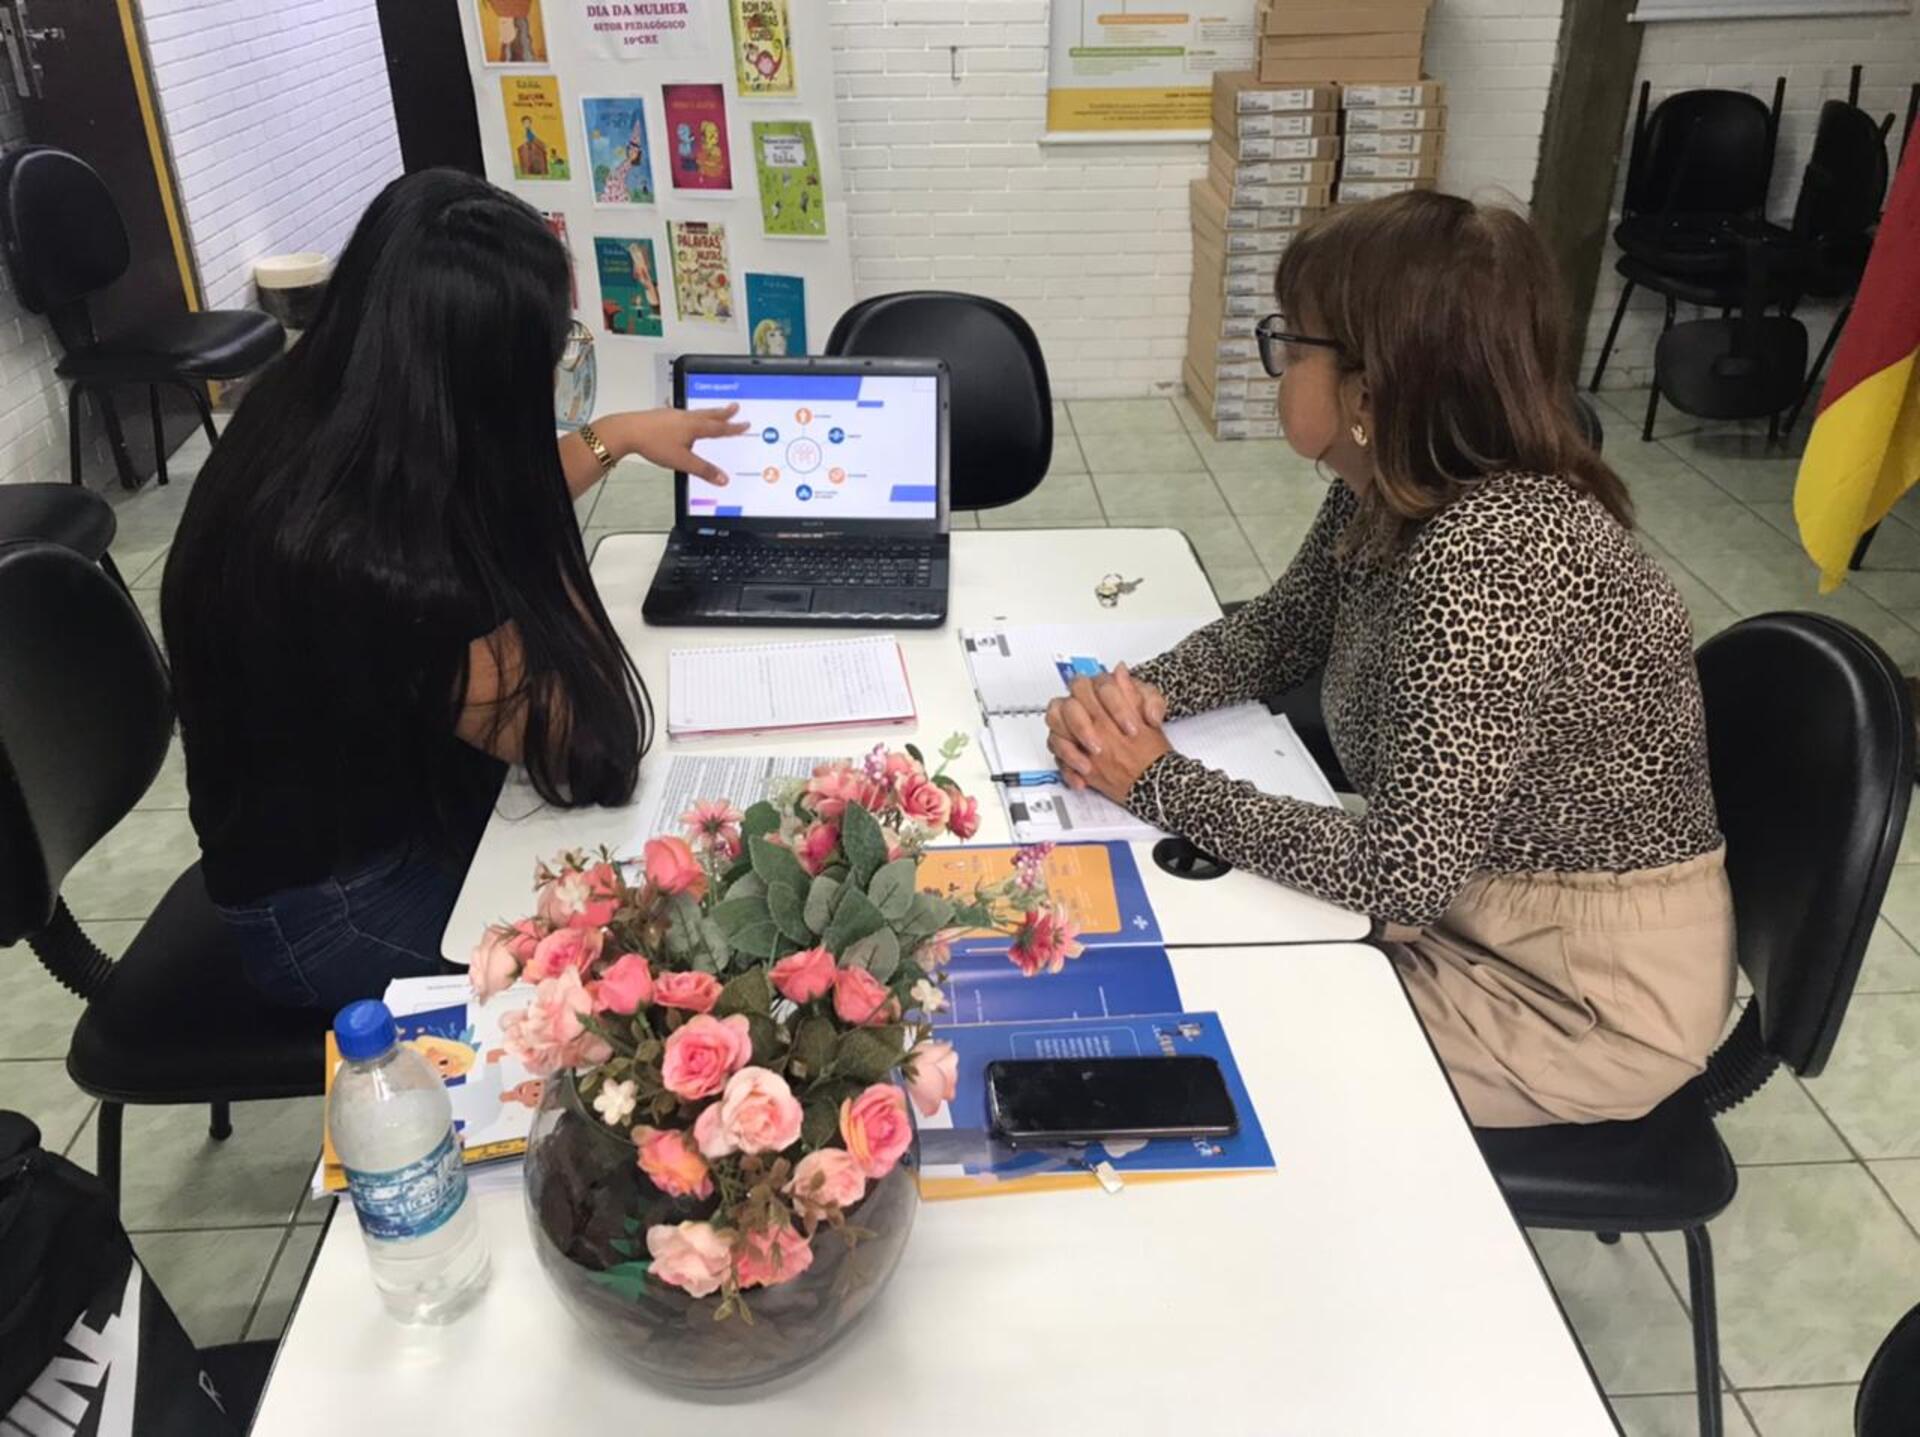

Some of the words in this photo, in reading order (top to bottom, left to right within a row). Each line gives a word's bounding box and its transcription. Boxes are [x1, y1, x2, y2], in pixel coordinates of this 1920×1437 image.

[587, 5, 609, 17] DIA
[612, 4, 632, 16] DA
[634, 2, 688, 15] MULHER
[593, 22, 622, 31] SETOR
[625, 18, 686, 30] PEDAGÓGICO
